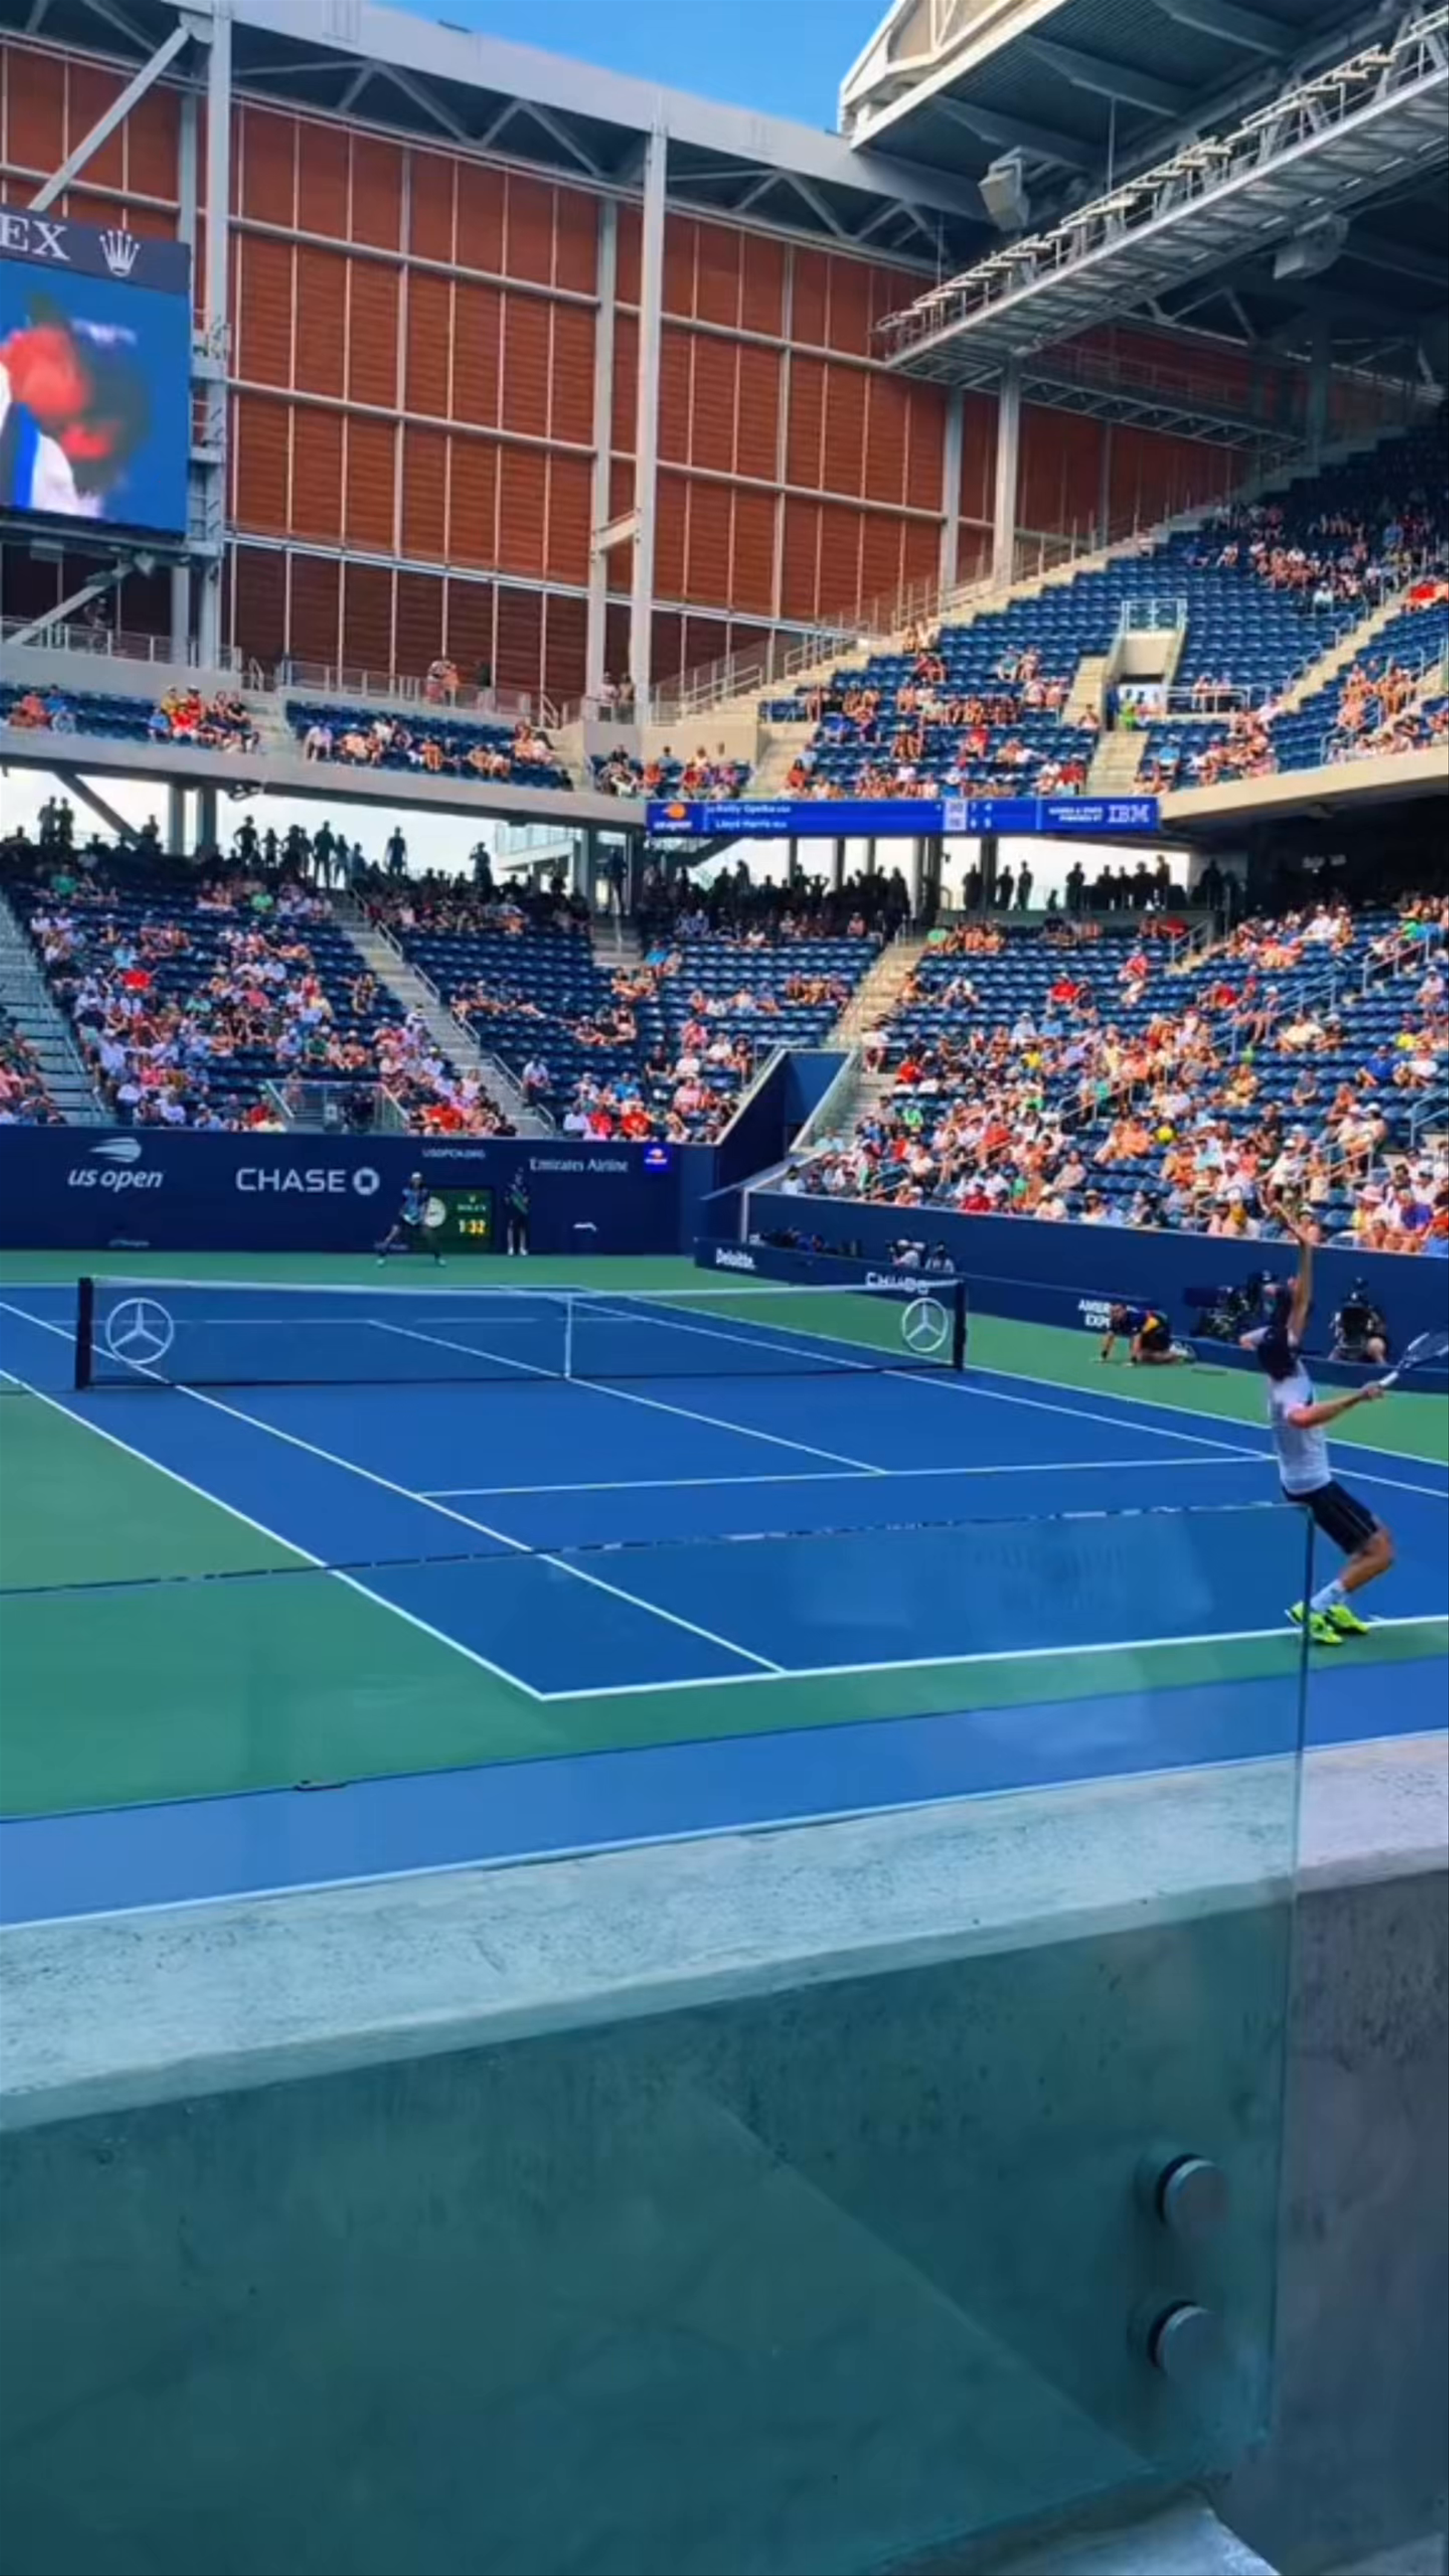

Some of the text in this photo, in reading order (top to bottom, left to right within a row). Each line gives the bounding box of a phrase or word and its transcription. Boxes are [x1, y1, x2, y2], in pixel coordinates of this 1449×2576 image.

[1108, 804, 1149, 823] IBM
[529, 1157, 584, 1172] Emirates
[67, 1169, 164, 1192] us open
[235, 1167, 346, 1193] CHASE
[1078, 1299, 1111, 1315] AMER
